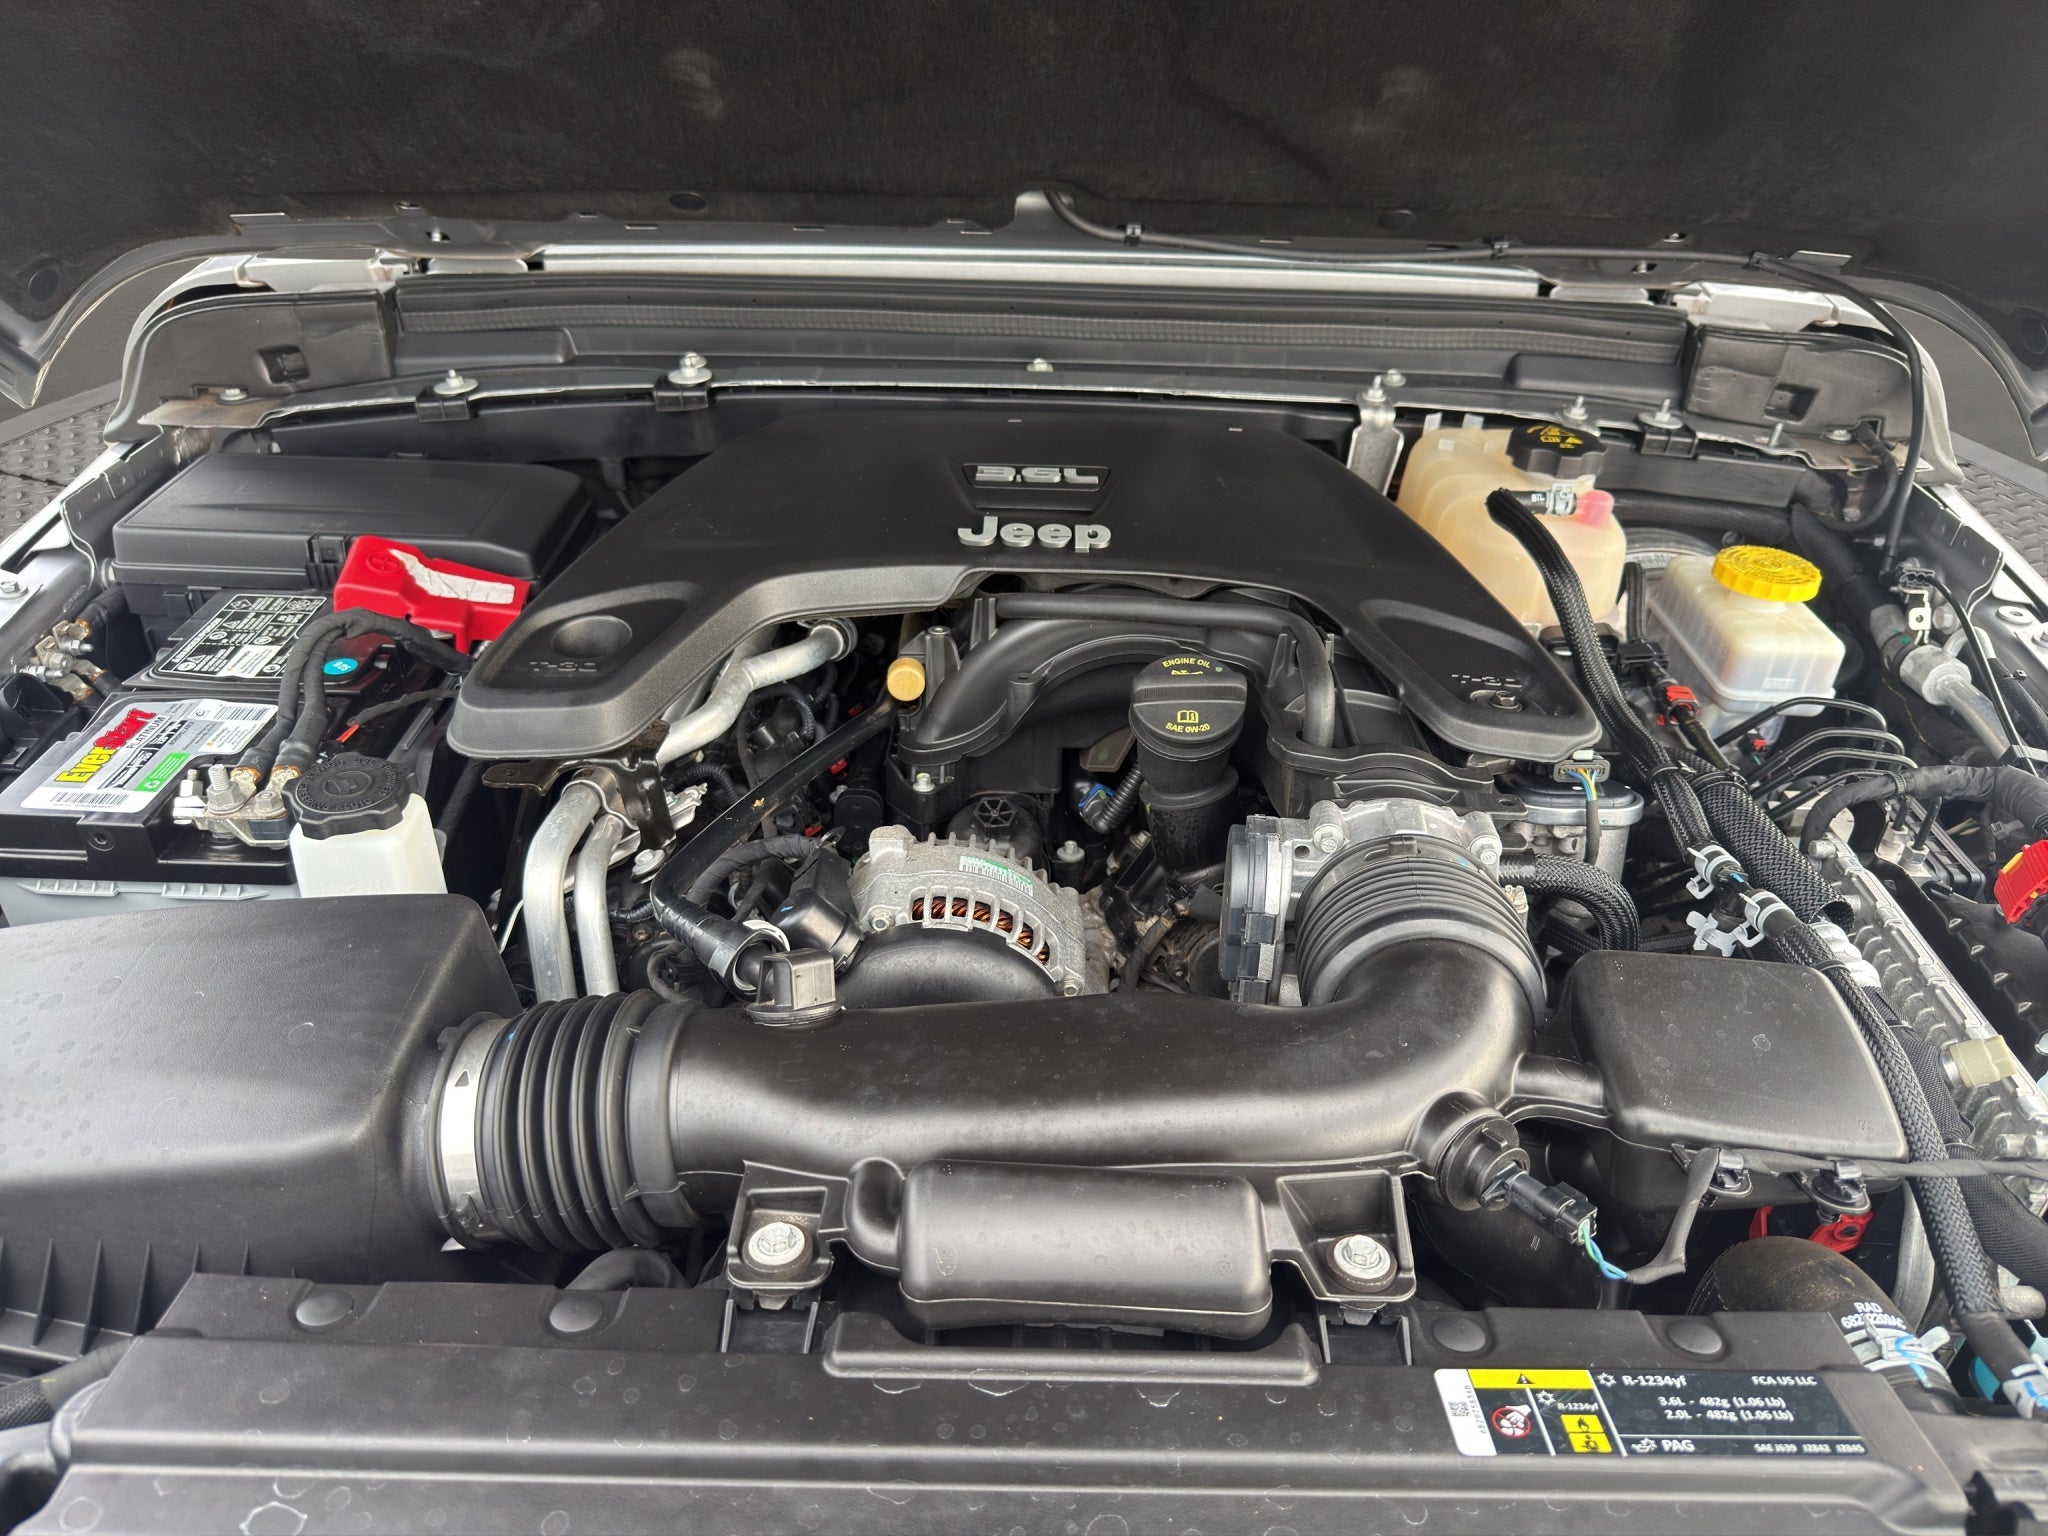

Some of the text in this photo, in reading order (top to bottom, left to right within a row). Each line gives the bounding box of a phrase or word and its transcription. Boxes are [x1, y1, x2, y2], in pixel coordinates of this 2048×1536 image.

[975, 466, 1099, 485] 3.6L
[957, 515, 1112, 553] Jeep
[1161, 657, 1211, 668] ENGINE OIL
[125, 716, 167, 749] PLATINUM
[1165, 722, 1211, 733] SAE 0W-20
[54, 708, 157, 783] EverStart
[1853, 1302, 1883, 1313] RAD
[1620, 1375, 1688, 1388] R-1234yf
[1752, 1376, 1818, 1386] FCA US LLC
[1556, 1402, 1599, 1412] R-1234yf
[1657, 1396, 1686, 1407] 3.6L
[1699, 1396, 1731, 1408] 482g
[1732, 1396, 1765, 1408] (1.06
[1766, 1396, 1786, 1408] Lb)
[1664, 1409, 1693, 1420] 2.0L
[1706, 1409, 1738, 1421] 482g
[1740, 1409, 1773, 1421] (1.06
[1773, 1409, 1794, 1422] Lb)
[1660, 1439, 1695, 1452] PAG
[1752, 1443, 1774, 1453] SAE
